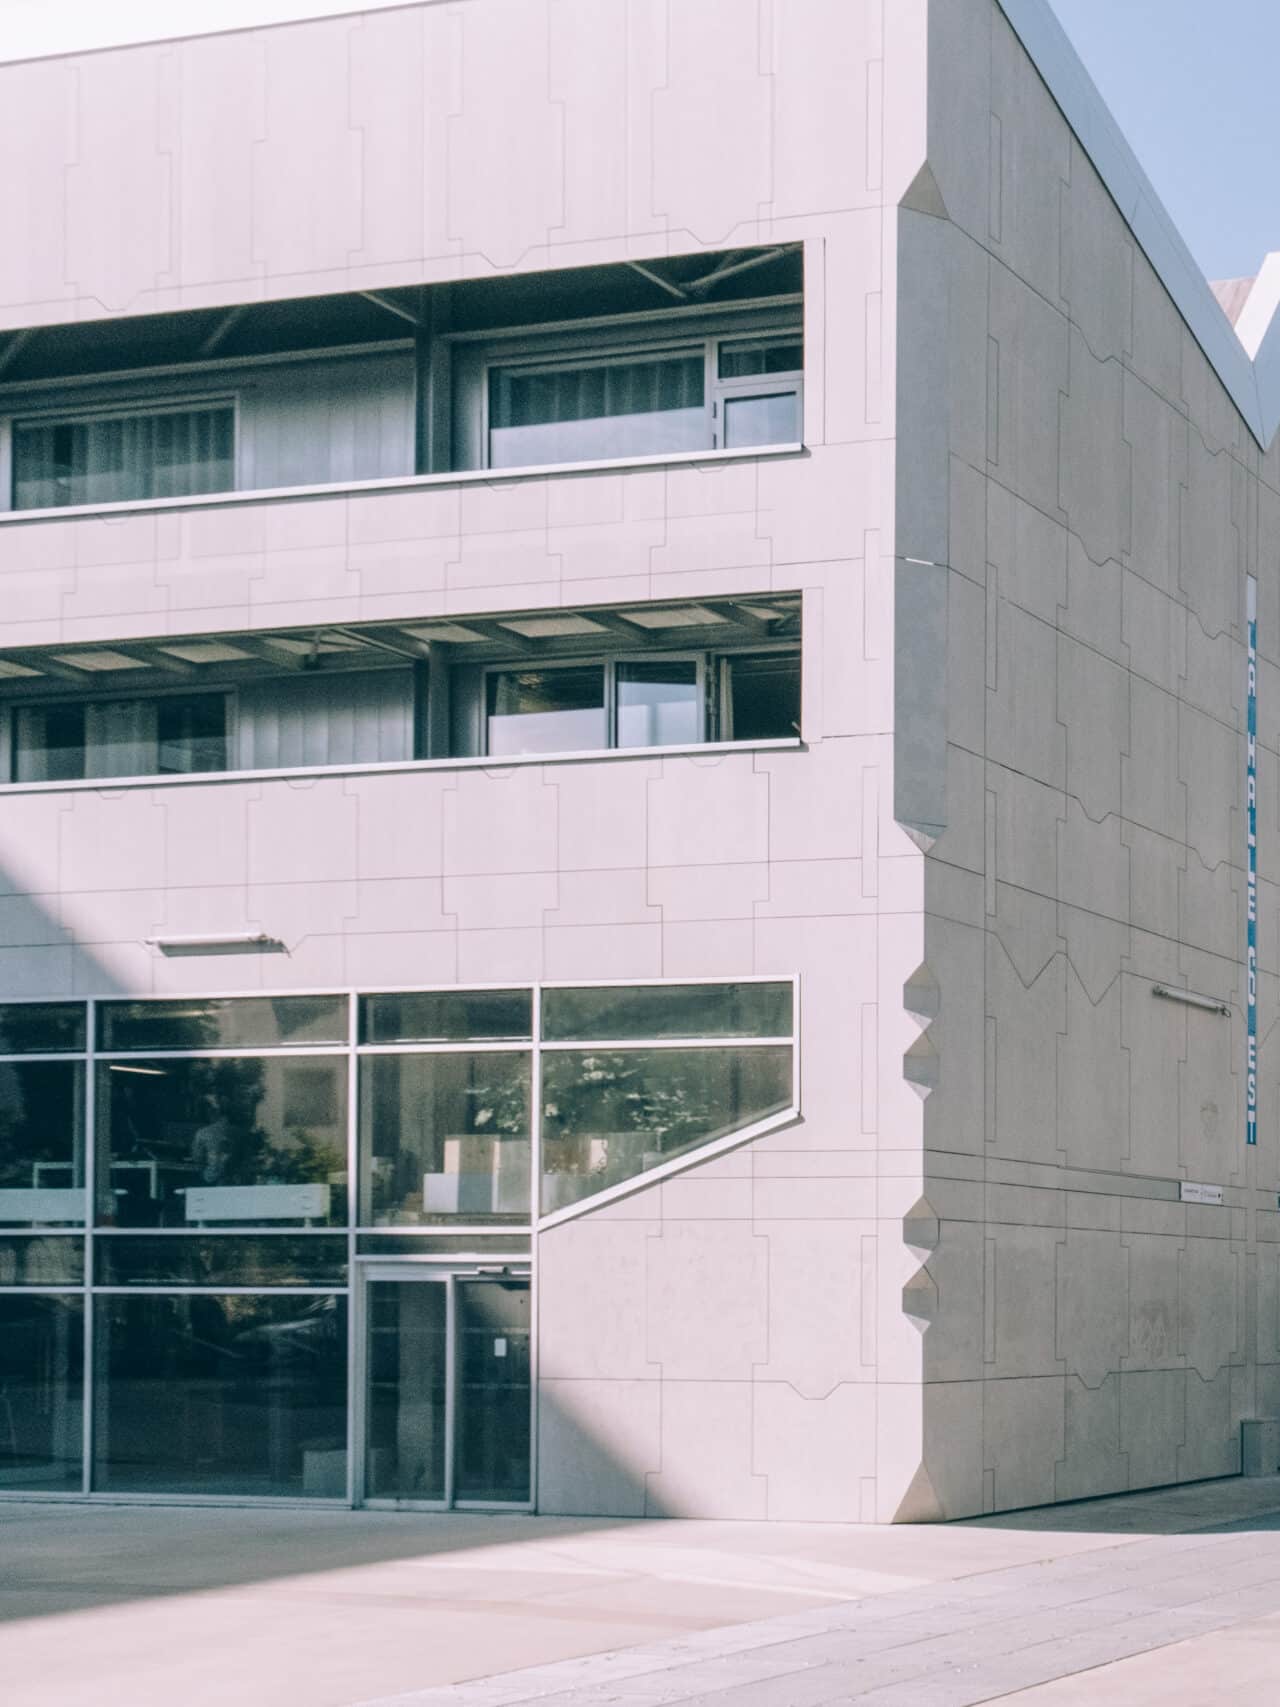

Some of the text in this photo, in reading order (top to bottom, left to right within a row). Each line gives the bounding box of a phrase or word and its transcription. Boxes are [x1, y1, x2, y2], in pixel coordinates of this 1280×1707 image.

[1248, 622, 1256, 1144] LA HALLE 6 EST
